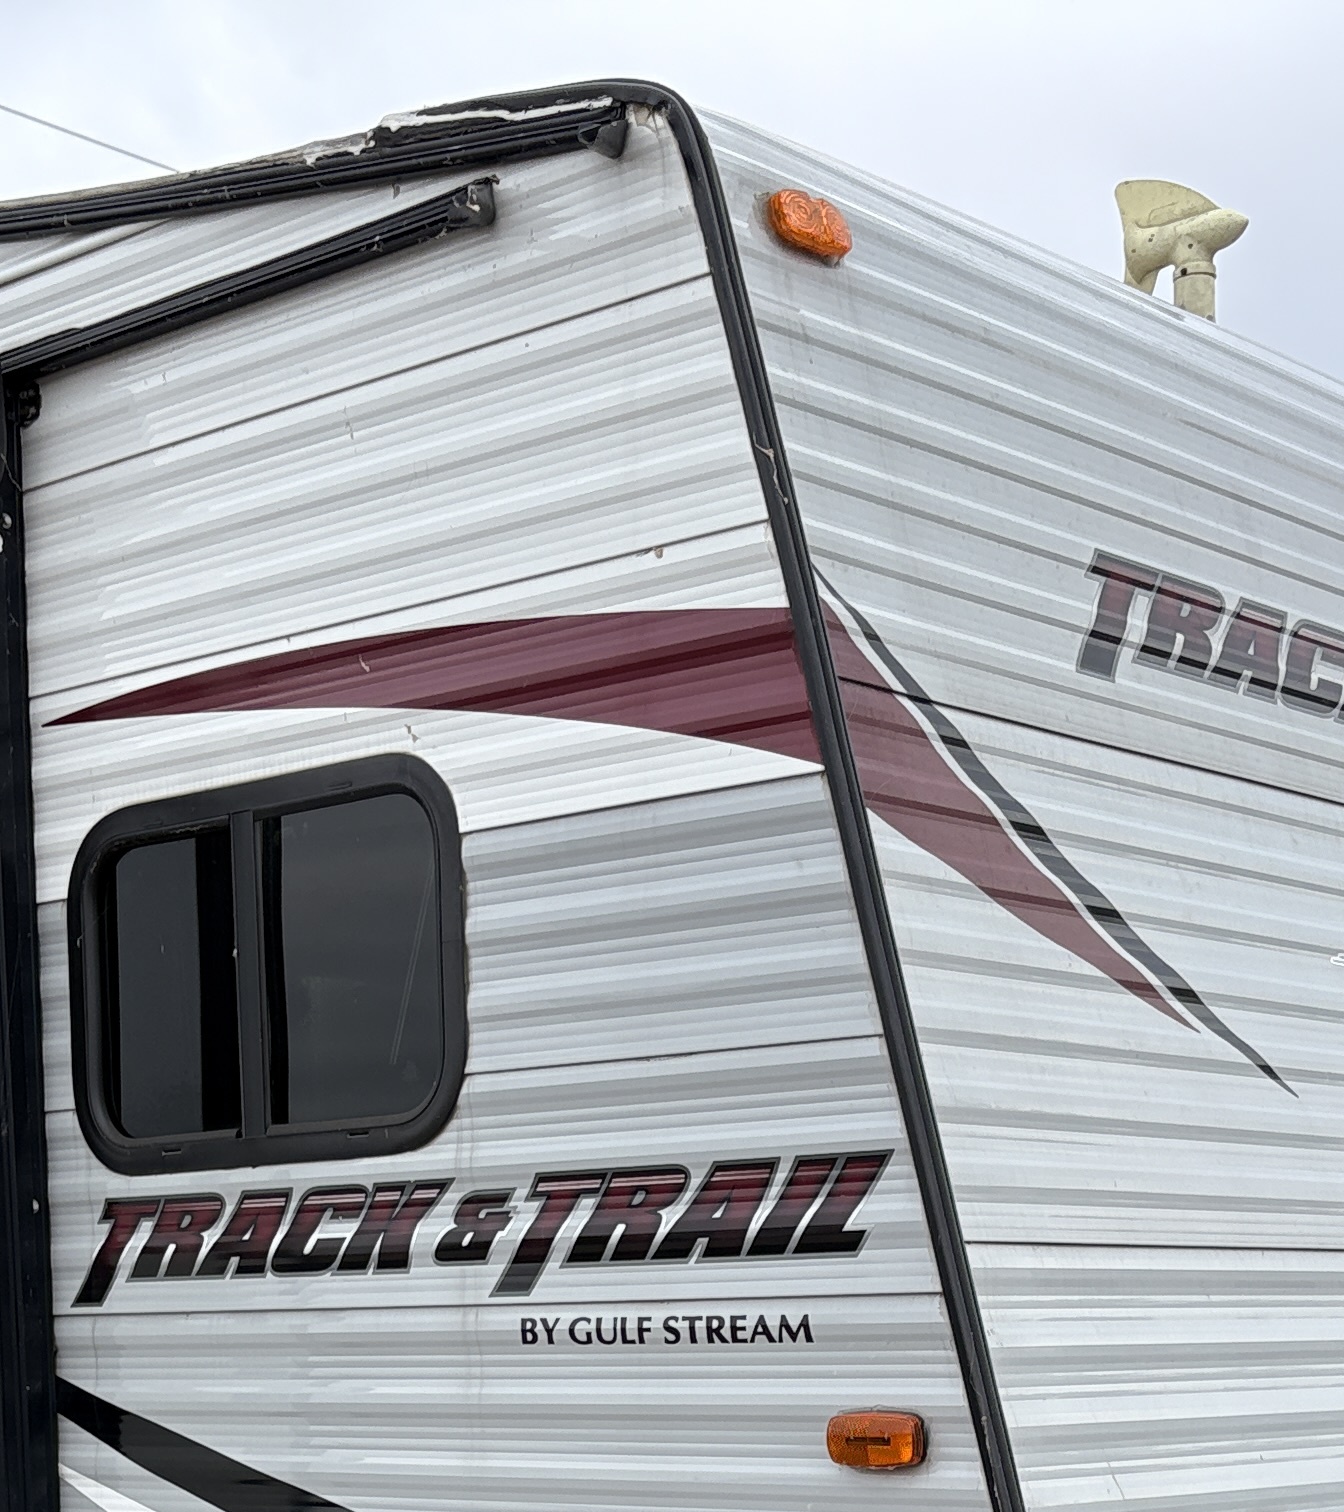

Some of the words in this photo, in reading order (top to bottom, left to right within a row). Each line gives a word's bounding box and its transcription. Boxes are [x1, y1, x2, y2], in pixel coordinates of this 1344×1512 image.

[70, 1177, 457, 1309] TRACK
[432, 1189, 522, 1267] &
[488, 1148, 896, 1299] TRAIL
[520, 1317, 561, 1346] BY
[567, 1316, 653, 1346] GULF
[662, 1313, 815, 1346] STREAM
